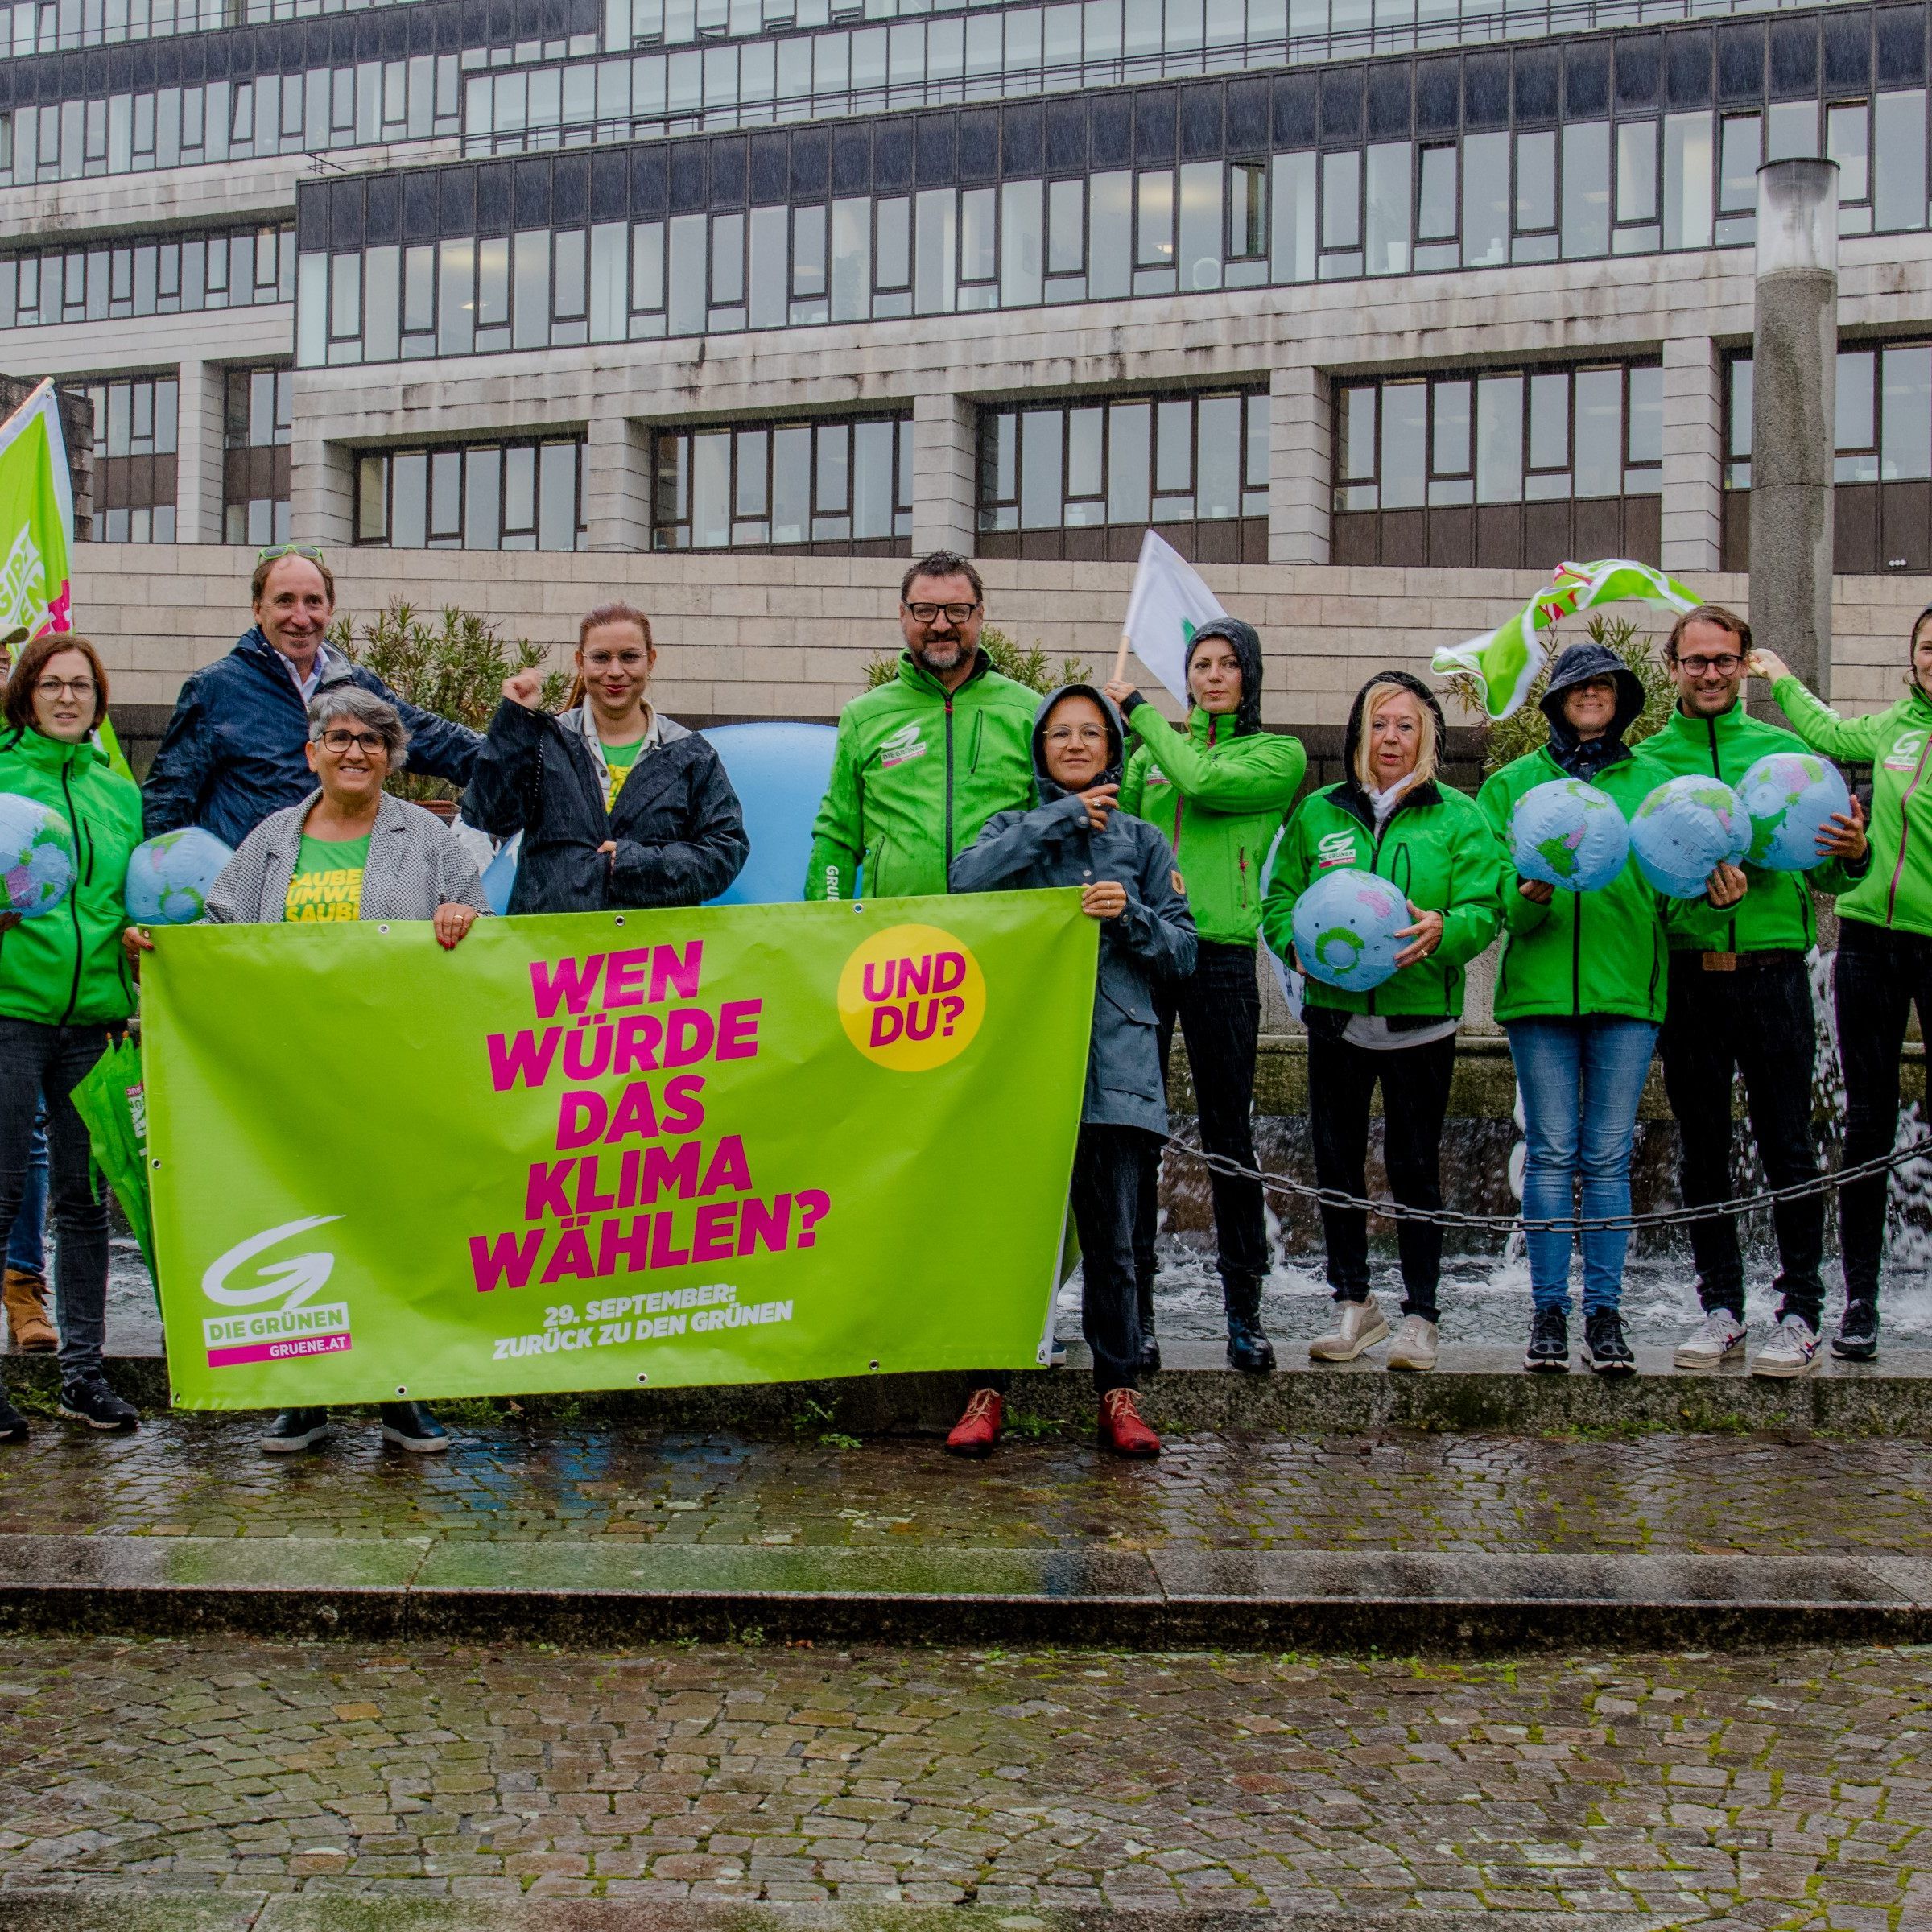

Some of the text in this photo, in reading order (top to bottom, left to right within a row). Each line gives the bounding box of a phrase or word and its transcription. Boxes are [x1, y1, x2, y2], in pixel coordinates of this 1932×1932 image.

[528, 939, 704, 1019] WEN
[862, 951, 966, 1002] UND
[485, 997, 763, 1092] WÜRDE
[869, 995, 965, 1048] DU?
[555, 1074, 707, 1151] DAS
[524, 1133, 753, 1221] KLIMA
[468, 1188, 832, 1294] WÄHLEN?
[208, 1308, 344, 1341] DIE GRÜNEN
[492, 1299, 794, 1360] ZURÜCK ZU DEN GRÜNEN
[543, 1283, 737, 1327] 29. SEPTEMBER:
[269, 1336, 346, 1357] GRUENE.AT
